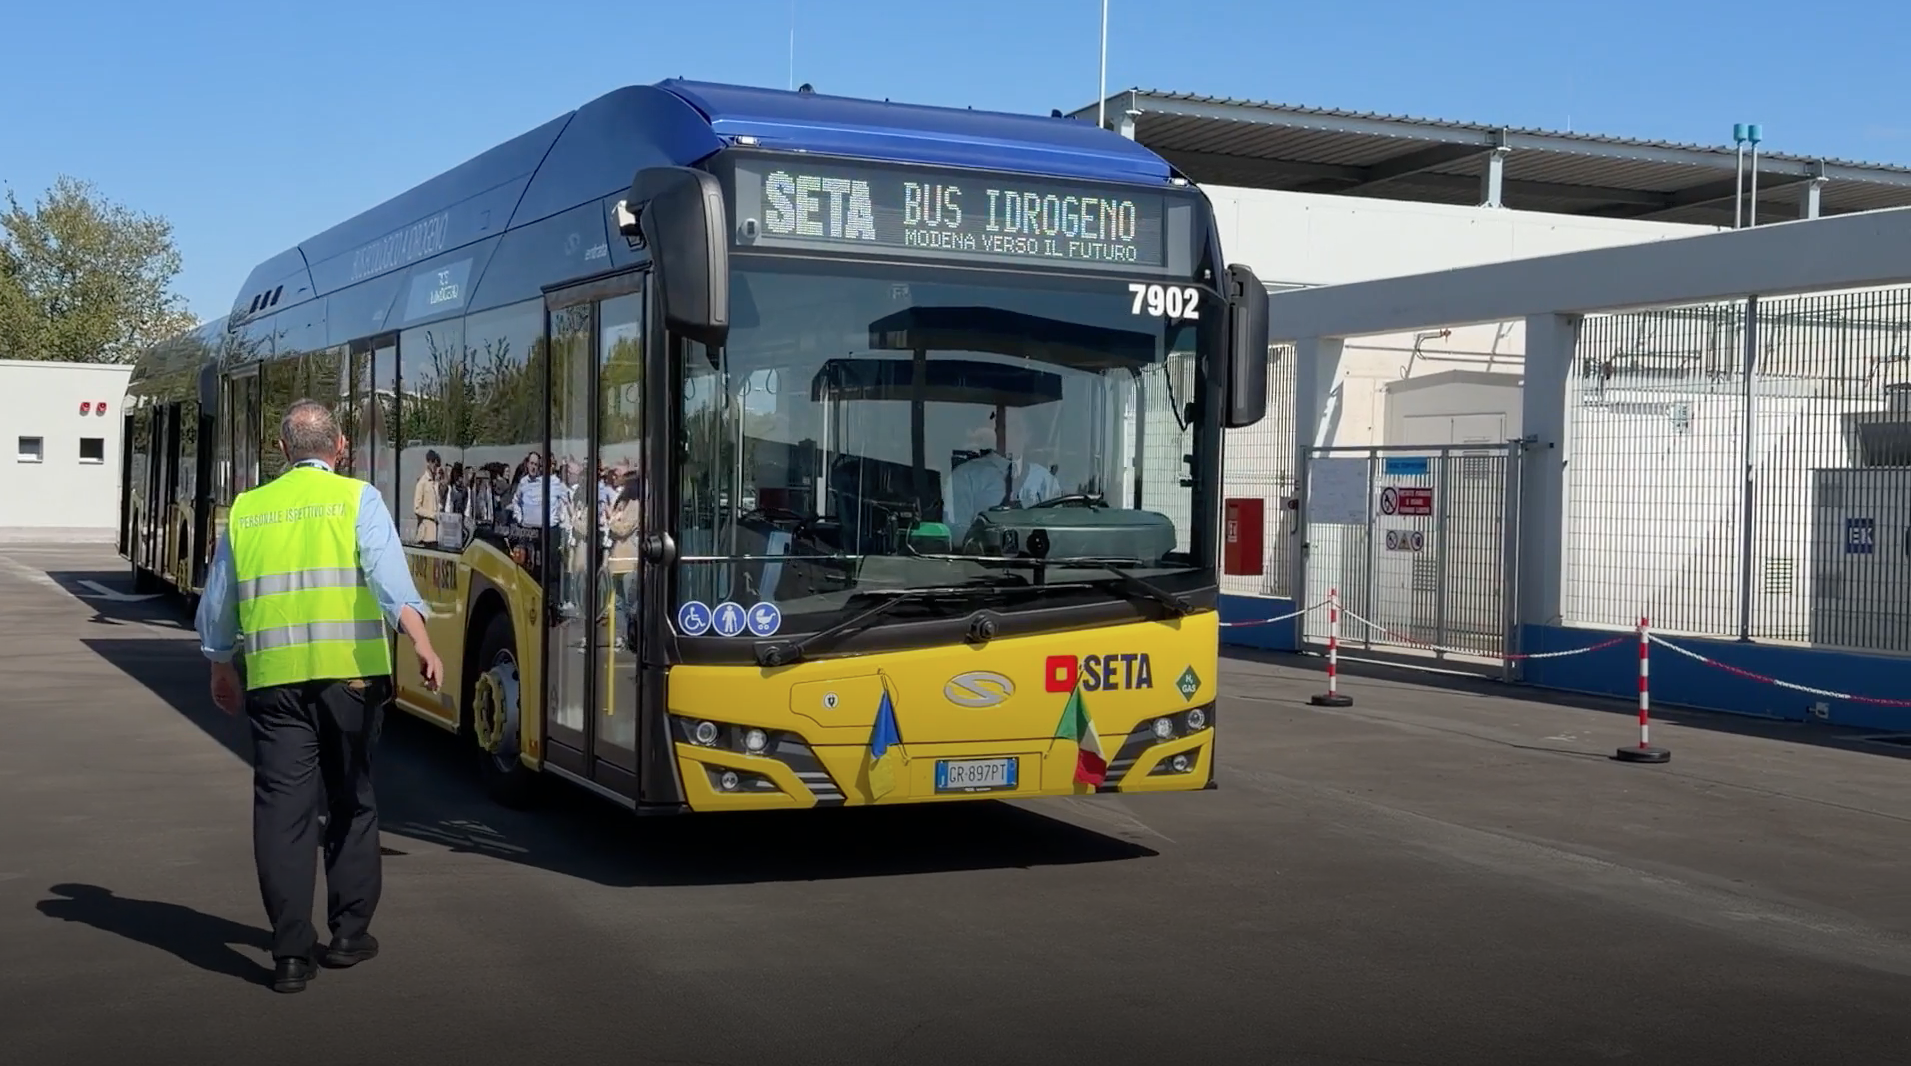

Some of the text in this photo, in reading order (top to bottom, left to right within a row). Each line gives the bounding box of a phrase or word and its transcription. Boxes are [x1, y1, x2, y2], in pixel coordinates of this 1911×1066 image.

[764, 171, 876, 240] SETA
[903, 181, 1137, 242] BUS IDROGENO
[904, 230, 1138, 262] MODENA VERSO IL FUTURO
[1128, 283, 1200, 320] 7902
[239, 502, 346, 529] PERSONALE ISPETTIVO SETA
[1848, 526, 1873, 545] EK
[1082, 653, 1154, 692] SETA
[1181, 684, 1197, 693] GAS
